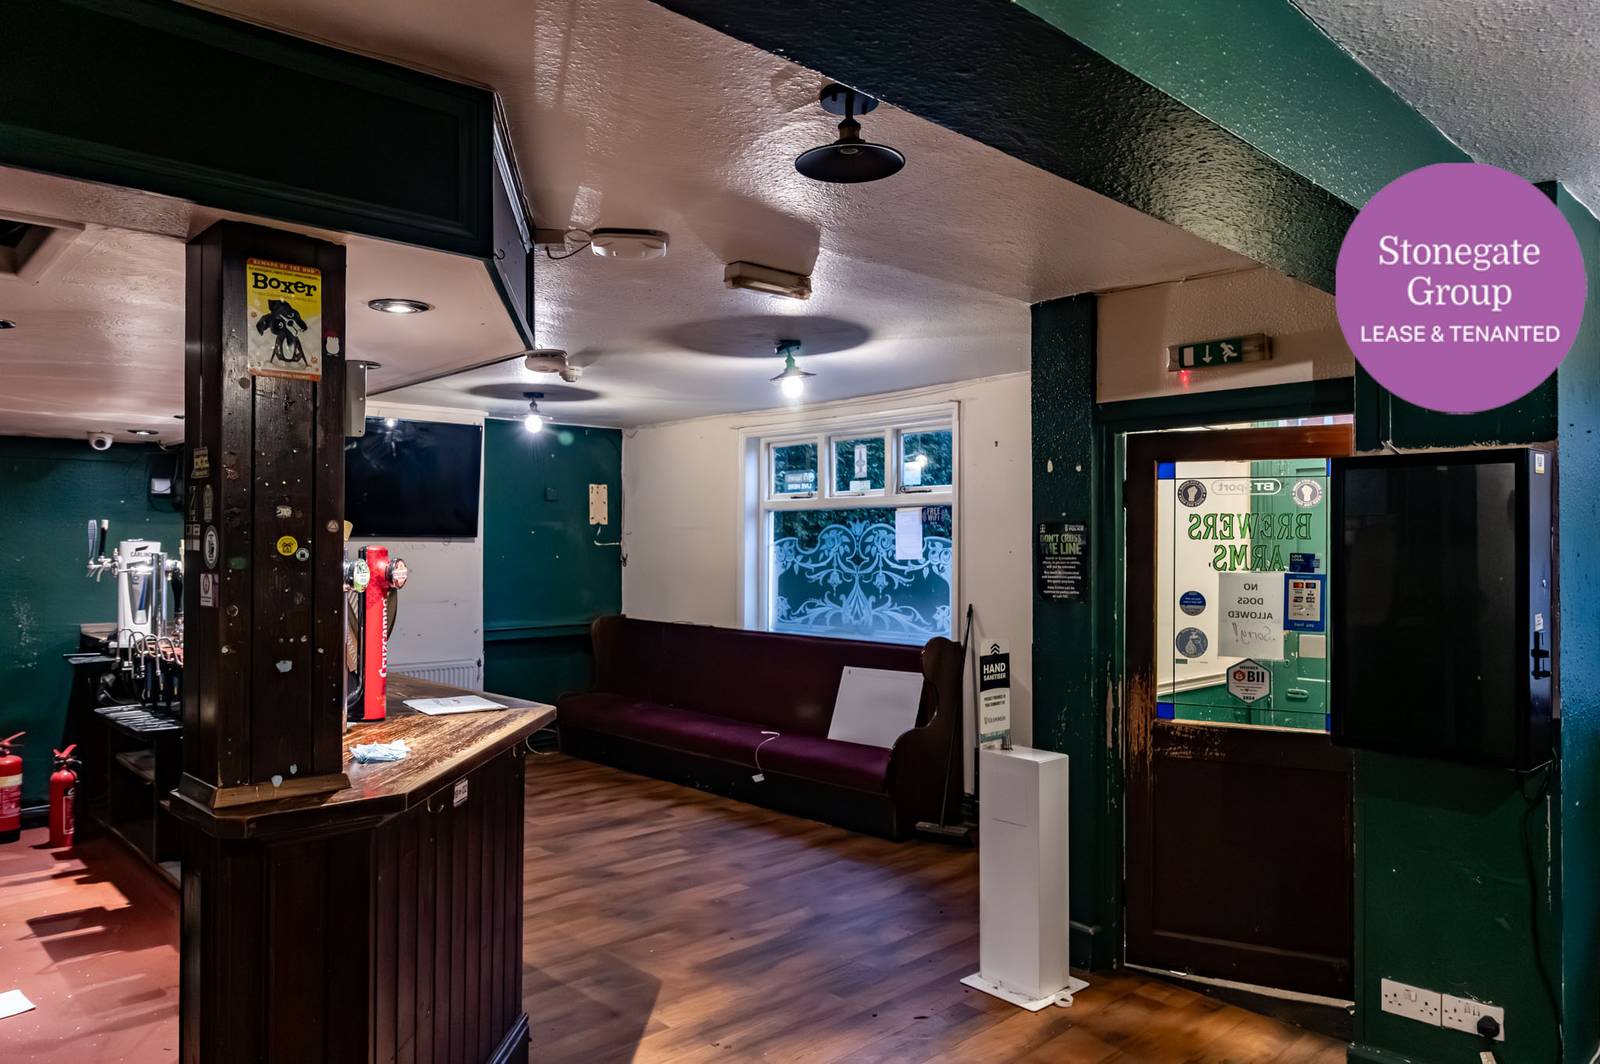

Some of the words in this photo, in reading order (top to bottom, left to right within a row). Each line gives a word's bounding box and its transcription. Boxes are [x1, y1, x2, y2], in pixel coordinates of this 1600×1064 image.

[252, 272, 317, 297] Boxer
[1060, 543, 1082, 555] LINE
[983, 662, 1006, 674] HAND
